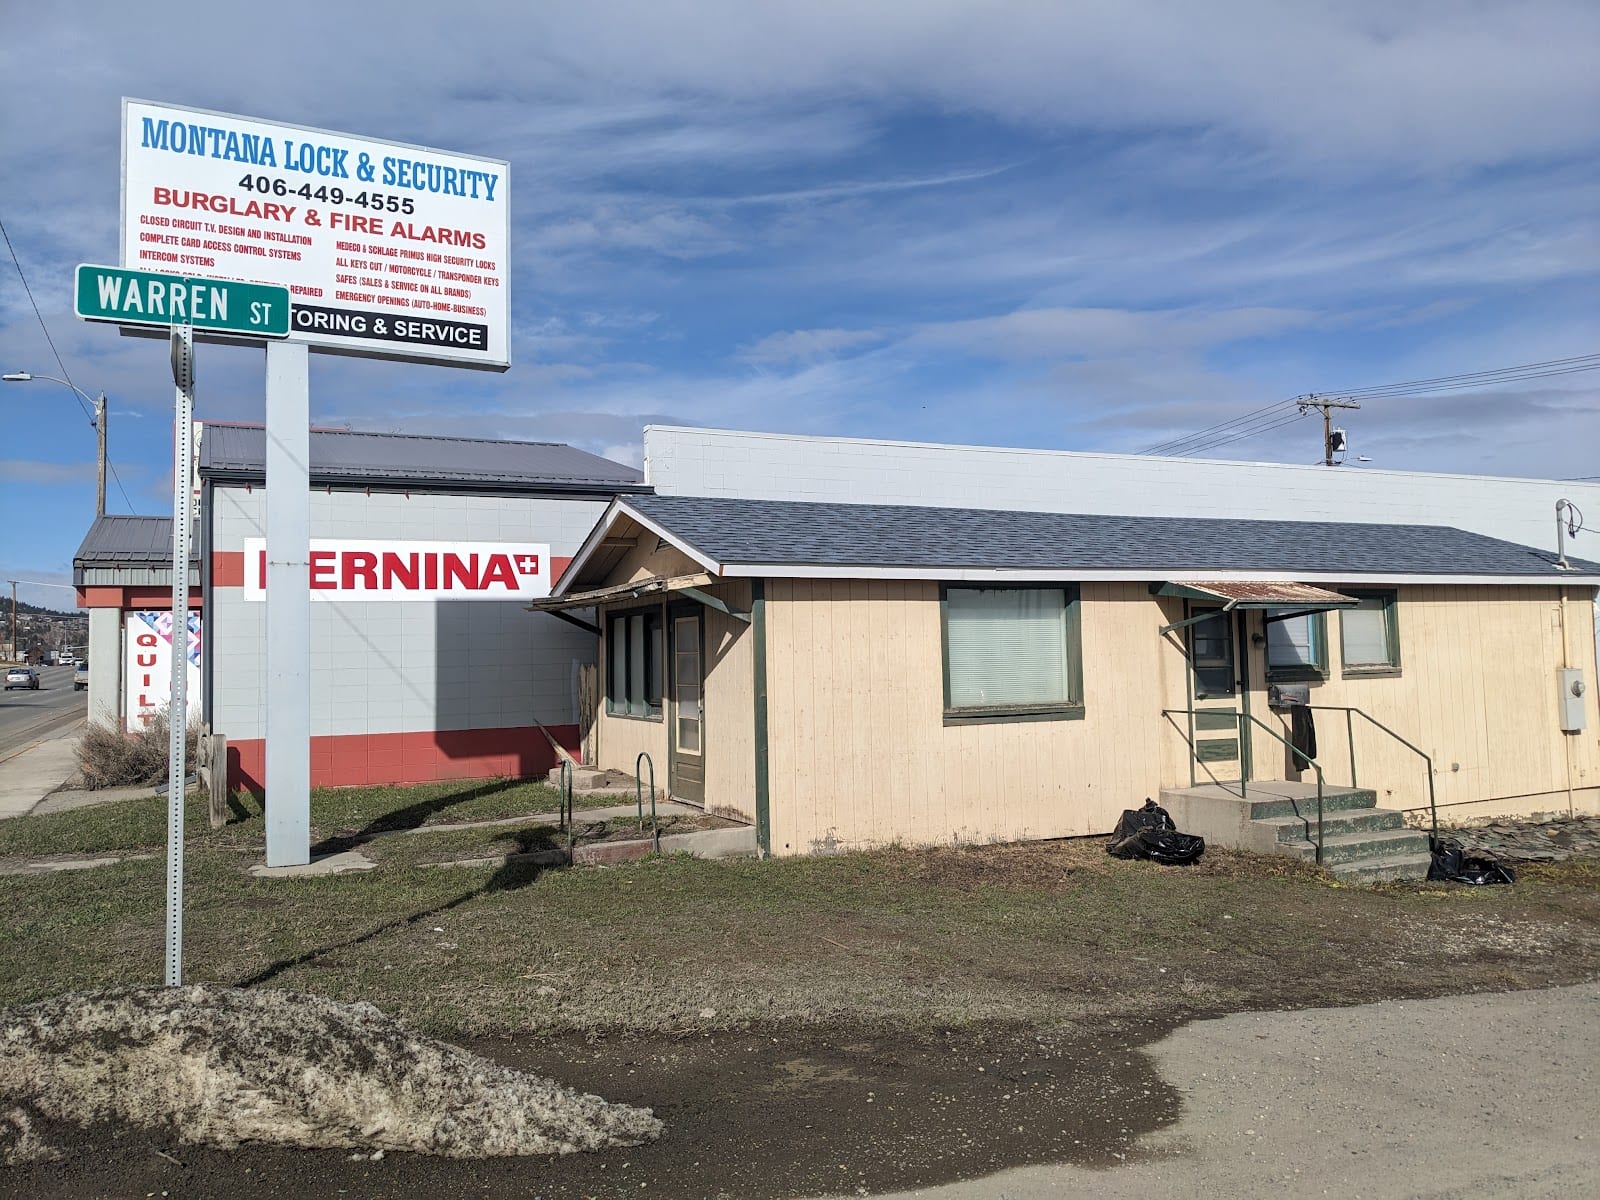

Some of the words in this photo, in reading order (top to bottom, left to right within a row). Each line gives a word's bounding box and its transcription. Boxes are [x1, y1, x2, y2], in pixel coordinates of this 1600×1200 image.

[141, 117, 276, 167] MONTANA
[285, 140, 348, 179] LOCK
[357, 153, 375, 182] &
[383, 157, 498, 201] SECURITY
[238, 174, 415, 214] 406-449-4555
[140, 215, 169, 227] CLOSED
[172, 219, 202, 231] CIRCUIT
[204, 223, 216, 233] T.V.
[219, 225, 245, 236] DESIGN
[248, 229, 261, 238] AND
[264, 231, 312, 245] INSTALLATION
[154, 187, 296, 223] BURGLARY
[305, 209, 321, 226] &
[330, 213, 383, 235] FIRE
[391, 221, 486, 249] ALARMS
[140, 233, 179, 245] COMPLETE
[182, 238, 200, 248] CARD
[203, 240, 231, 251] ACCESS
[234, 244, 266, 257] CONTROL
[269, 249, 301, 261] SYSTEMS
[140, 250, 178, 262] INTERCOM
[180, 255, 214, 267] SYSTEMS
[336, 241, 360, 252] MEDECO
[363, 244, 366, 253] &
[369, 245, 398, 257] SCHLAGE
[400, 249, 424, 260] PRIMUS
[427, 253, 441, 263] HIGH
[444, 255, 473, 267] SECURITY
[476, 259, 495, 270] LOCKS
[336, 258, 348, 267] ALL
[350, 260, 367, 270] KEYS
[370, 262, 383, 271] CUT
[389, 264, 431, 277] MOTORCYCLE
[438, 271, 481, 284] TRANSPONDER
[484, 276, 499, 287] KEYS
[336, 274, 356, 284] SAFES
[359, 277, 382, 287] (SALES
[385, 280, 389, 288] &
[391, 280, 418, 292] SERVICE
[420, 284, 429, 293] ON
[431, 286, 442, 295] ALL
[444, 288, 471, 299] BRANDS)
[97, 275, 227, 320] WARREN
[250, 302, 271, 325] ST
[291, 285, 322, 297] REPAIRED
[336, 291, 375, 303] EMERGENCY
[377, 295, 409, 307] OPENINGS
[412, 300, 486, 317] (AUTO-HOME-BUSINESS)
[374, 318, 388, 334] &
[394, 320, 481, 344] SERVICE
[259, 550, 520, 591] ERNINA
